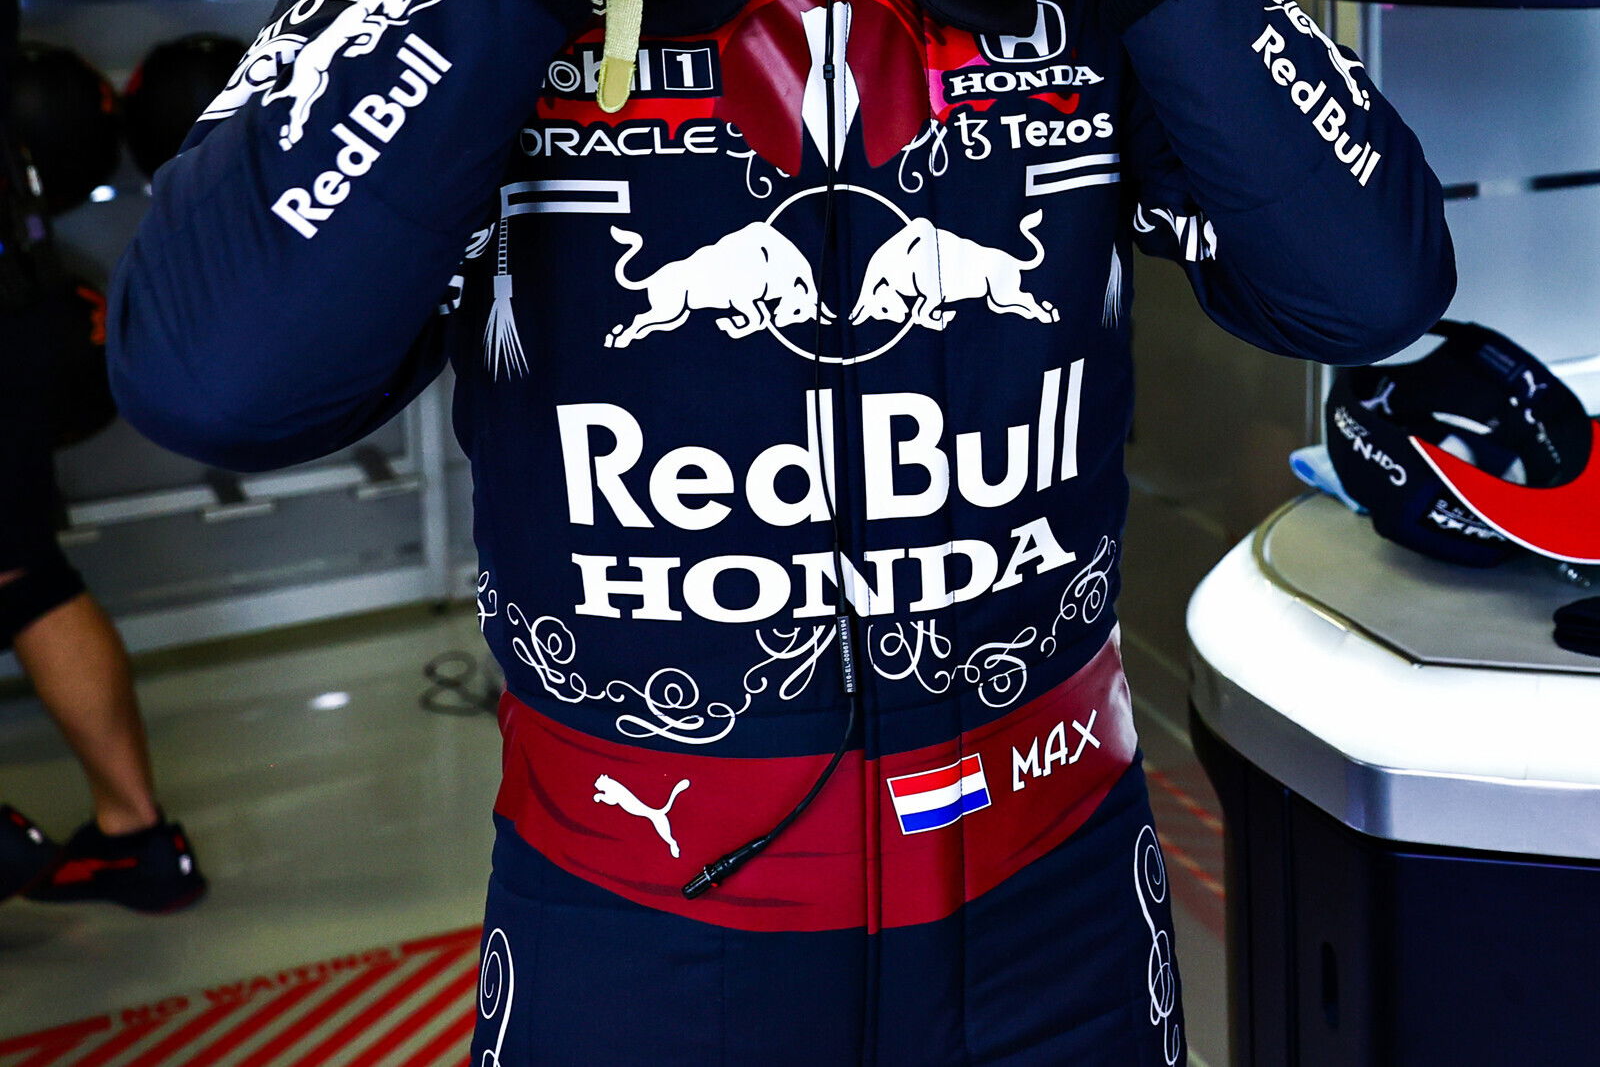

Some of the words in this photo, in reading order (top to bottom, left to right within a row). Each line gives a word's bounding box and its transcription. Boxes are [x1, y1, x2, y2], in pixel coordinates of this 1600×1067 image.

[950, 64, 1105, 98] HONDA
[1251, 23, 1327, 114] Red
[1312, 96, 1381, 187] Bull
[271, 123, 381, 239] Red
[349, 32, 453, 144] Bull
[520, 125, 719, 157] ORACLE
[1000, 111, 1114, 150] Tezos
[555, 389, 835, 531] Red
[861, 358, 1085, 521] Bull
[570, 516, 1077, 624] HONDA
[1012, 708, 1101, 792] MAX
[121, 995, 189, 1027] NO
[204, 947, 391, 1006] WAITING
